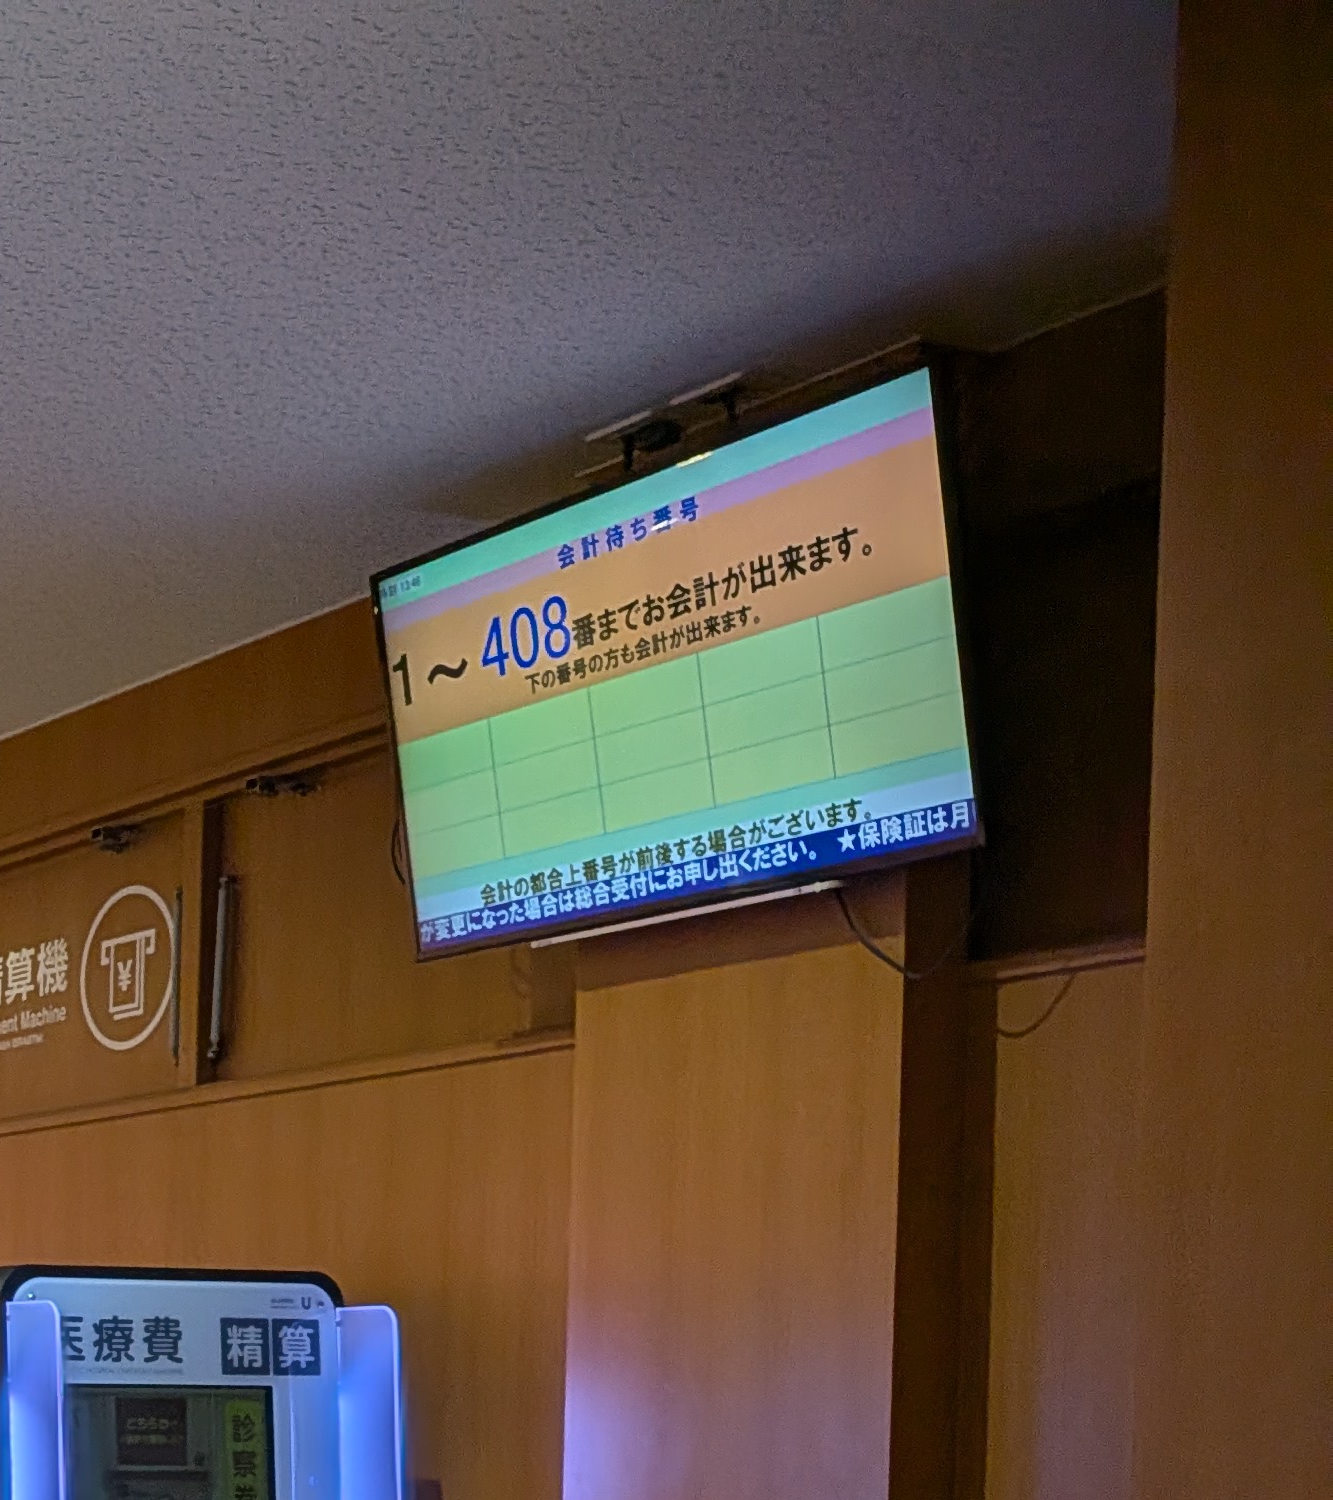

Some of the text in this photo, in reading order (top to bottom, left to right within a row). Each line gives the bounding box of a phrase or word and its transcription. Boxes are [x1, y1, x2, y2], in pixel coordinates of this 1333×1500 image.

[557, 496, 699, 569] 会計待ち番号
[20, 1004, 67, 1030] Machine
[226, 1323, 315, 1369] 精算
